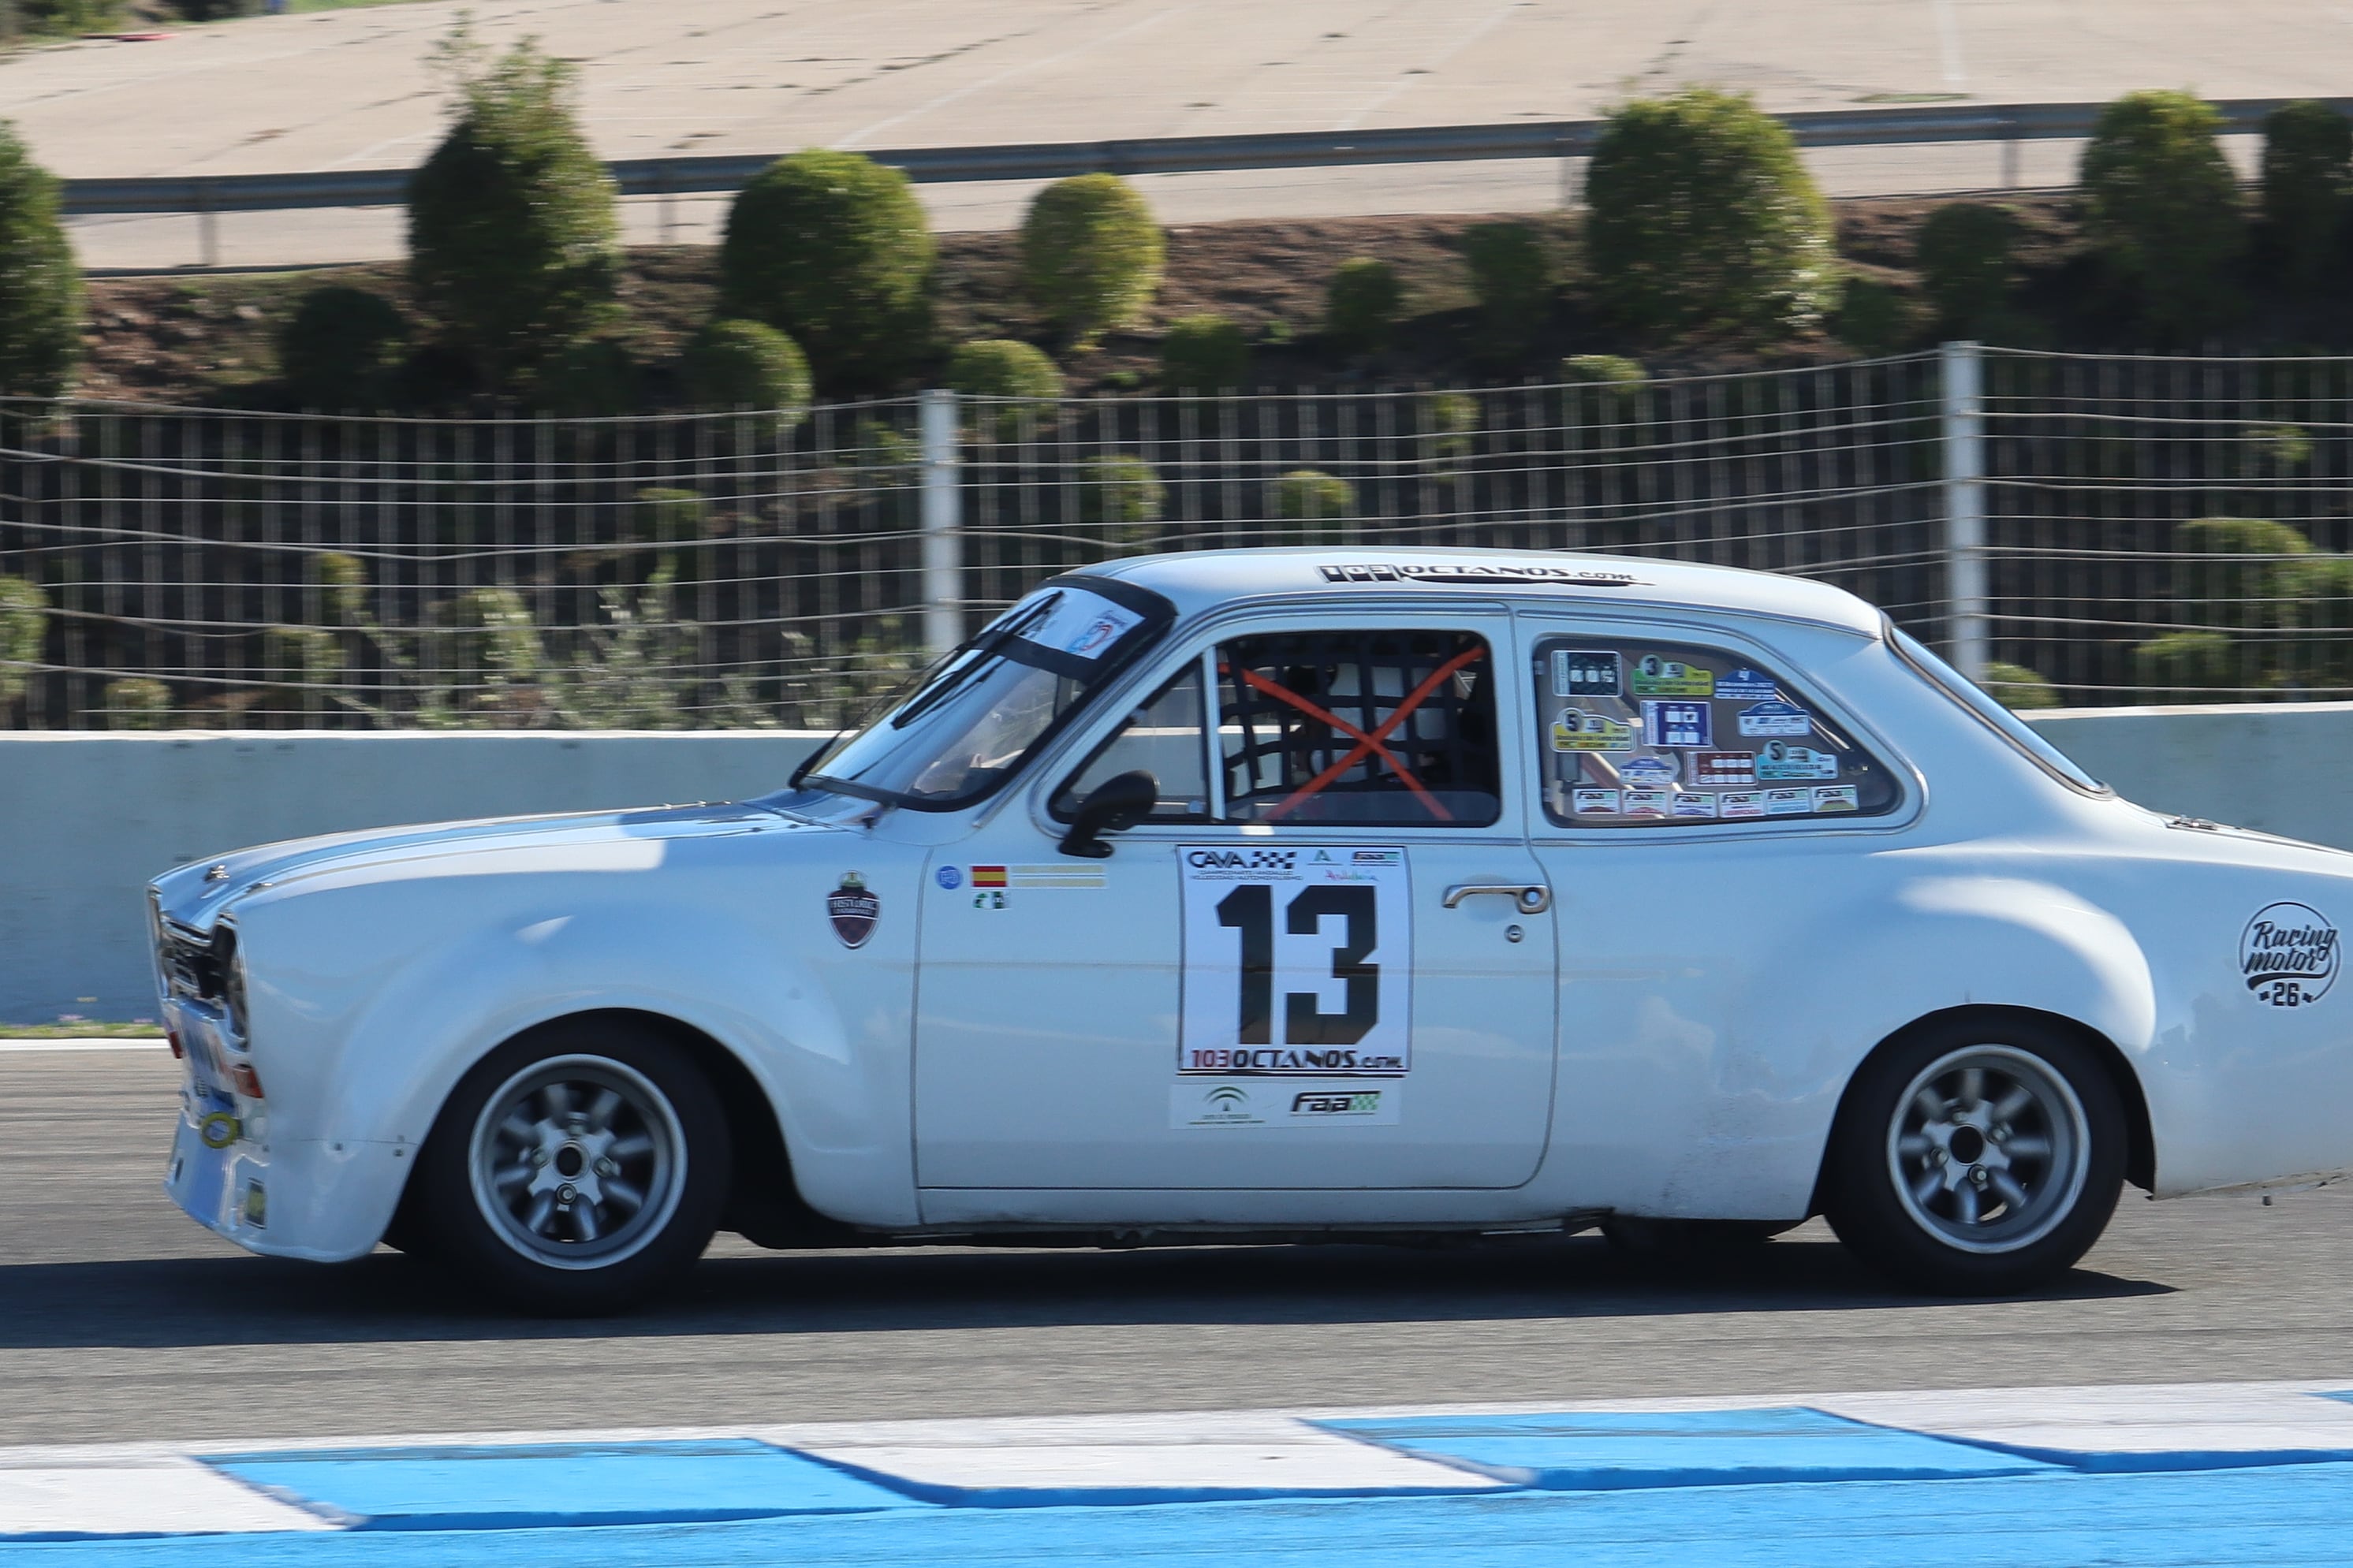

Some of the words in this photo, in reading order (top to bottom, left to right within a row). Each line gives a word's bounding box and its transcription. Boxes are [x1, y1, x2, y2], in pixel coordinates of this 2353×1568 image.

[1188, 851, 1248, 868] CAVA
[2253, 921, 2337, 962] Racing
[1215, 885, 1379, 1045] 13
[2243, 948, 2315, 974] motor
[2273, 982, 2299, 1006] 26
